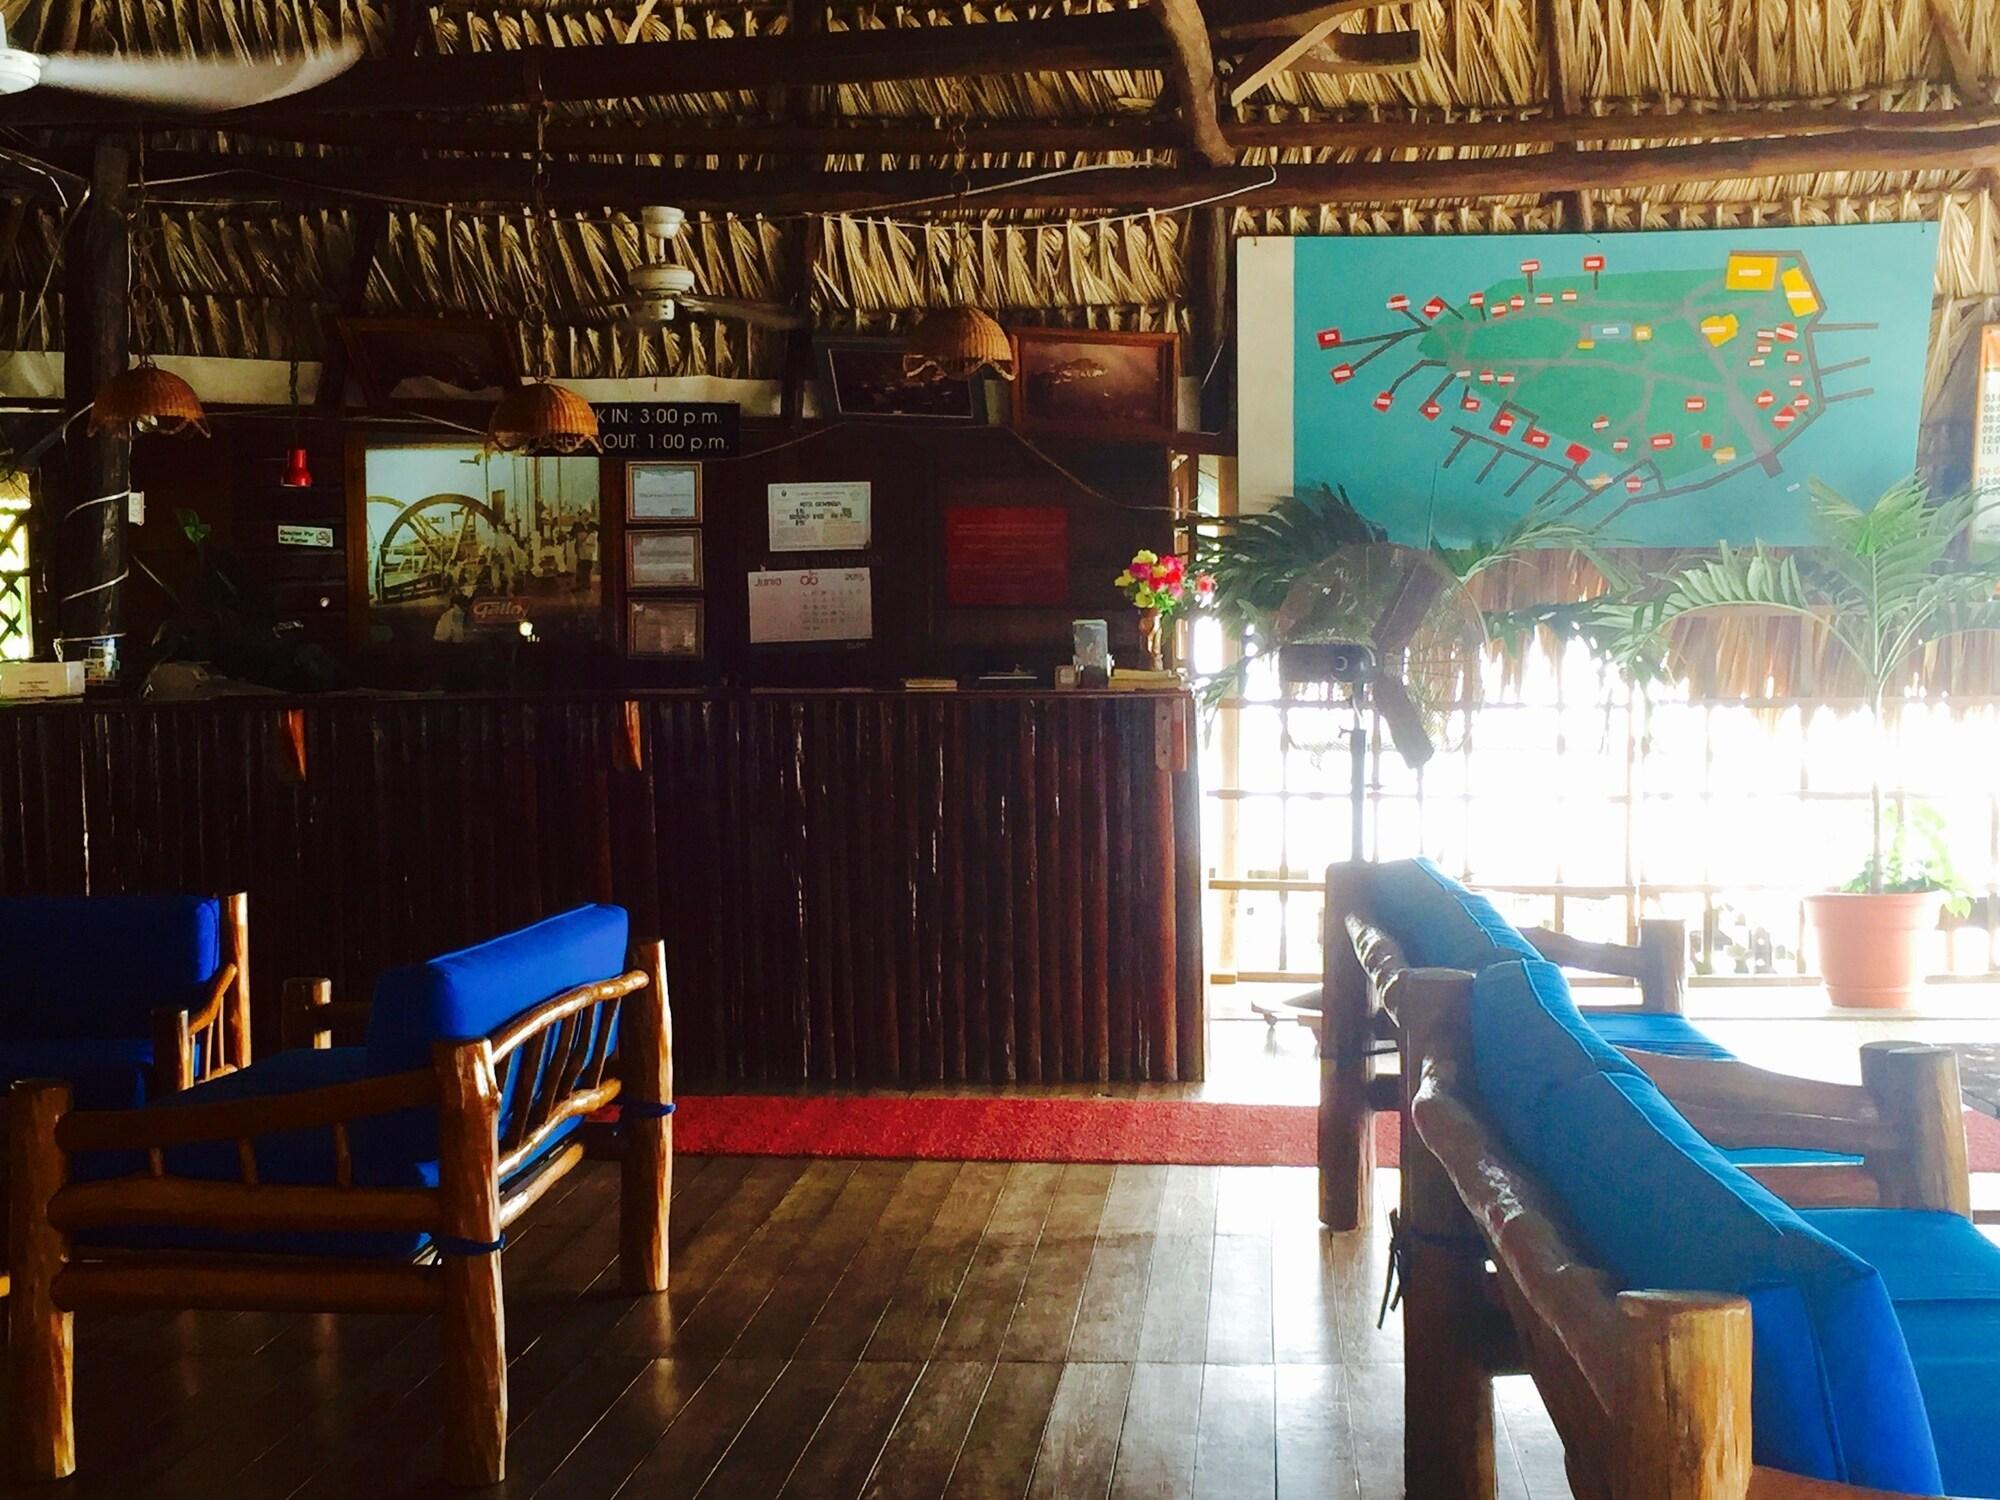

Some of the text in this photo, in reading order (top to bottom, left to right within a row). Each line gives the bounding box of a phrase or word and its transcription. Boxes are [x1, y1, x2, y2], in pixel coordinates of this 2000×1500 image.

[611, 408, 633, 424] IN:
[640, 408, 678, 424] 3:00
[684, 411, 722, 427] p.m.
[648, 433, 685, 449] 1:00
[691, 437, 730, 452] p.m.
[754, 576, 782, 587] Junio
[472, 600, 523, 619] Gallo
